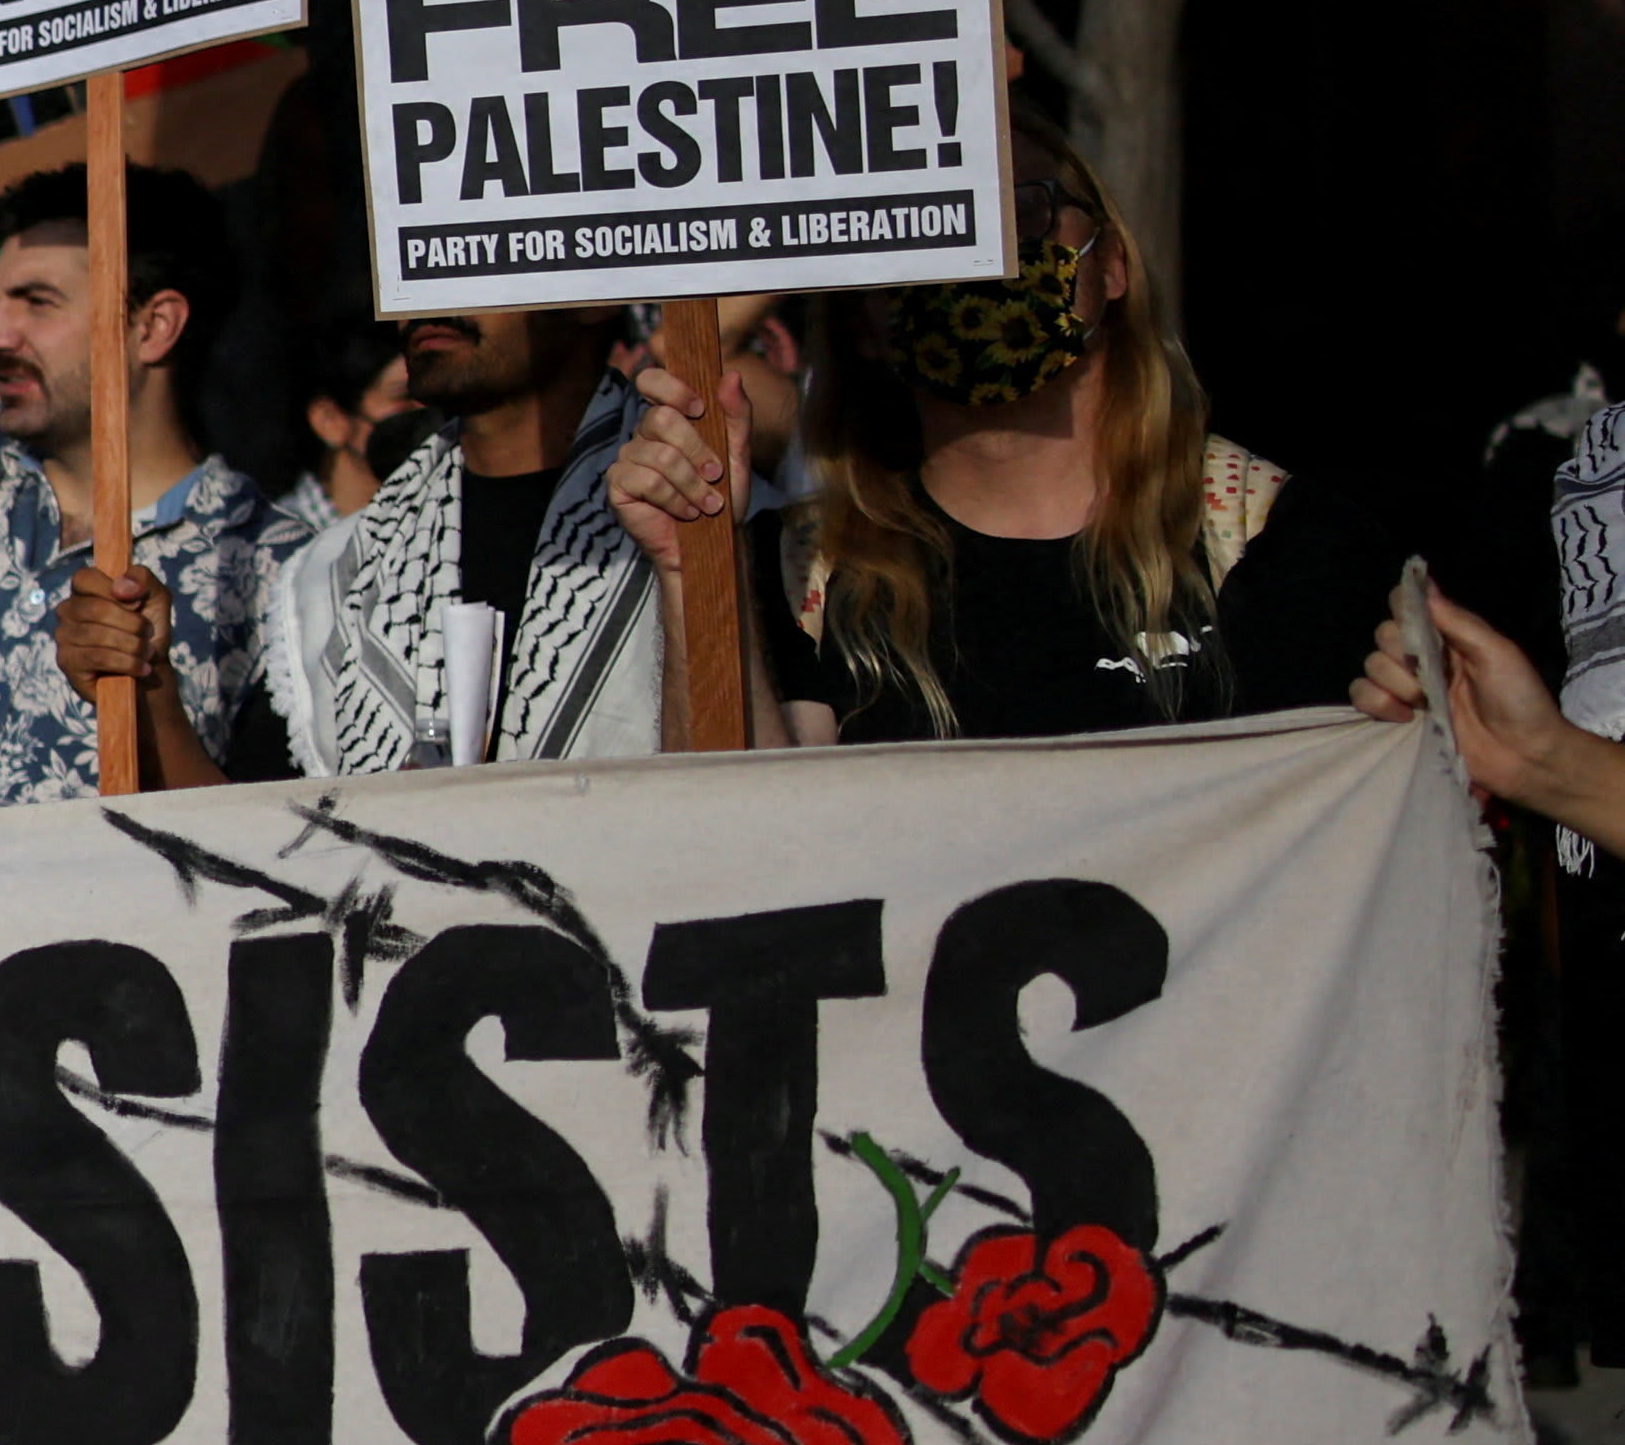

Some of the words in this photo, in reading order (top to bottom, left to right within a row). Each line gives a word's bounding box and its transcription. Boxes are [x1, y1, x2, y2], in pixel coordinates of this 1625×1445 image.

[390, 60, 963, 204] PALESTINE!
[406, 232, 499, 270] PARTY
[508, 226, 565, 262] FOR
[574, 218, 737, 259] SOCIALISM
[747, 217, 772, 248] &
[781, 203, 968, 245] LIBERATION
